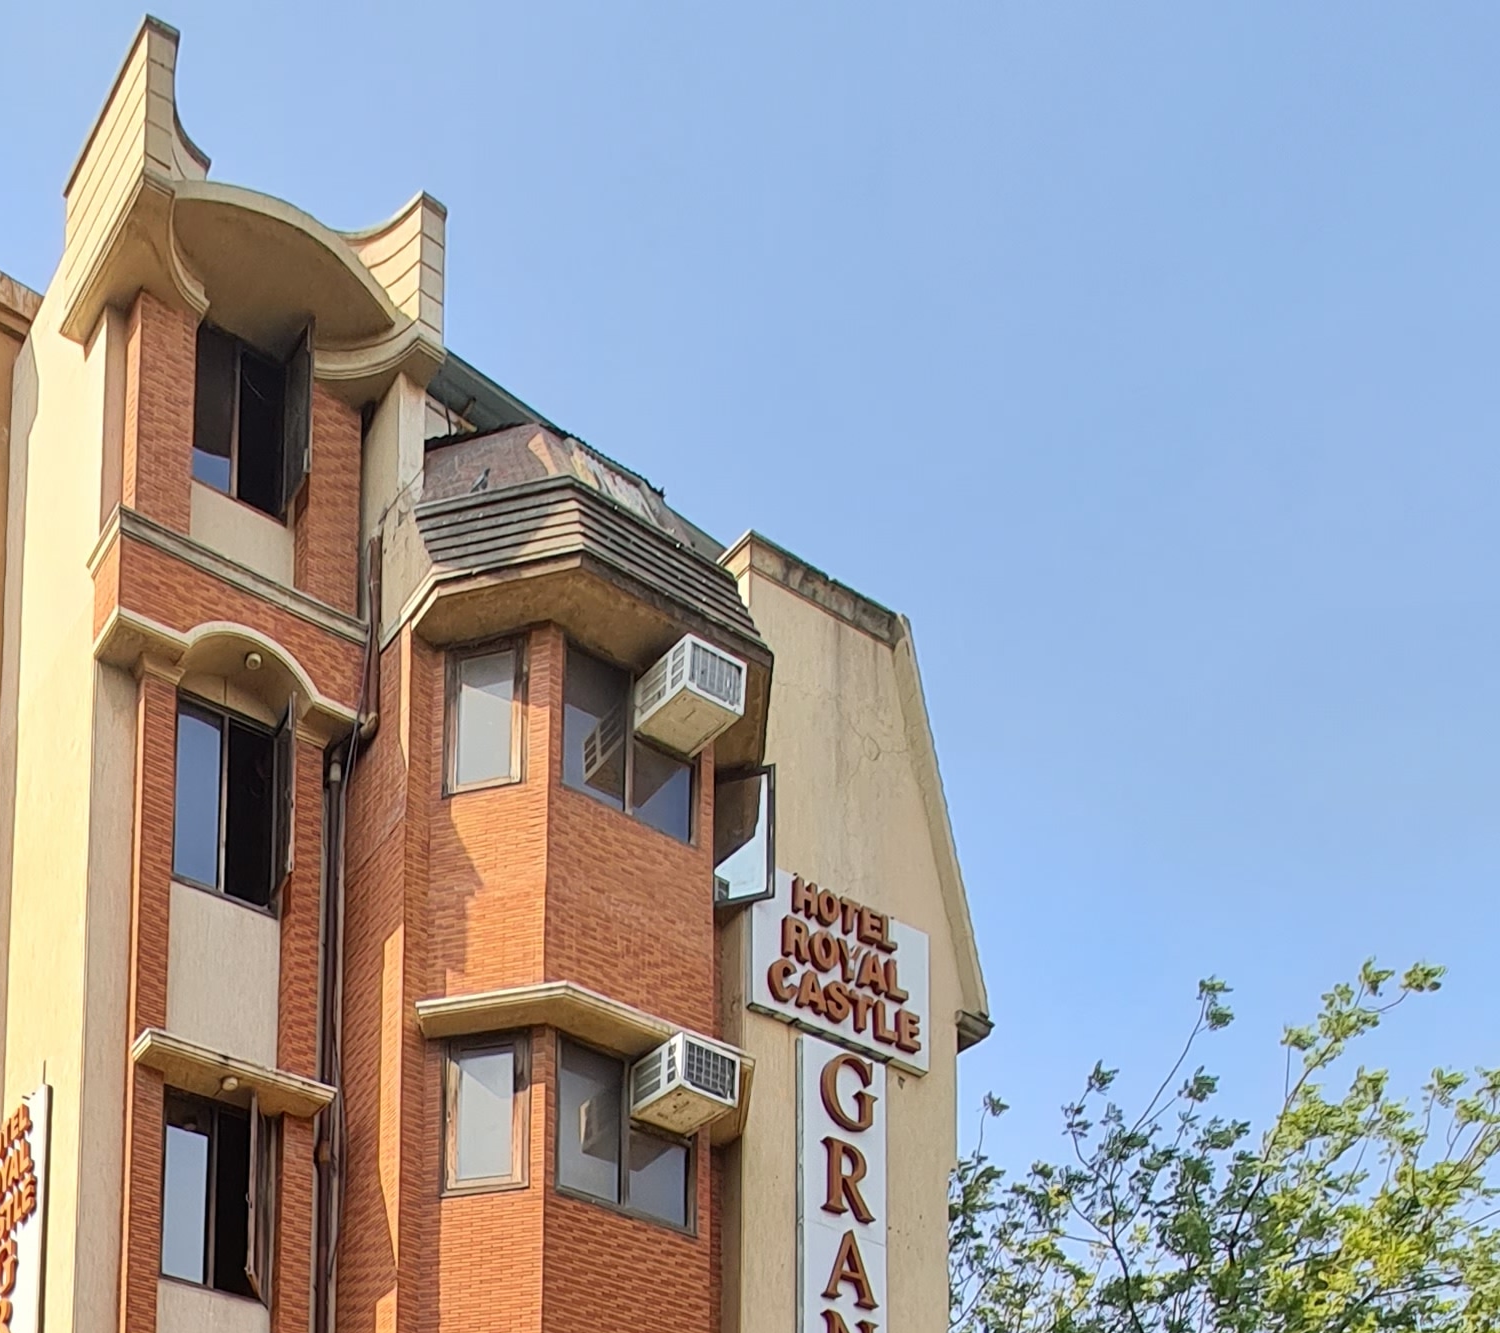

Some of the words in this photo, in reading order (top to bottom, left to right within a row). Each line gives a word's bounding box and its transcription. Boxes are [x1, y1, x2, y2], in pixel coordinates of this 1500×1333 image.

[791, 874, 899, 952] HOTEL
[780, 914, 910, 1004] ROYAL
[766, 958, 922, 1054] CASTLE
